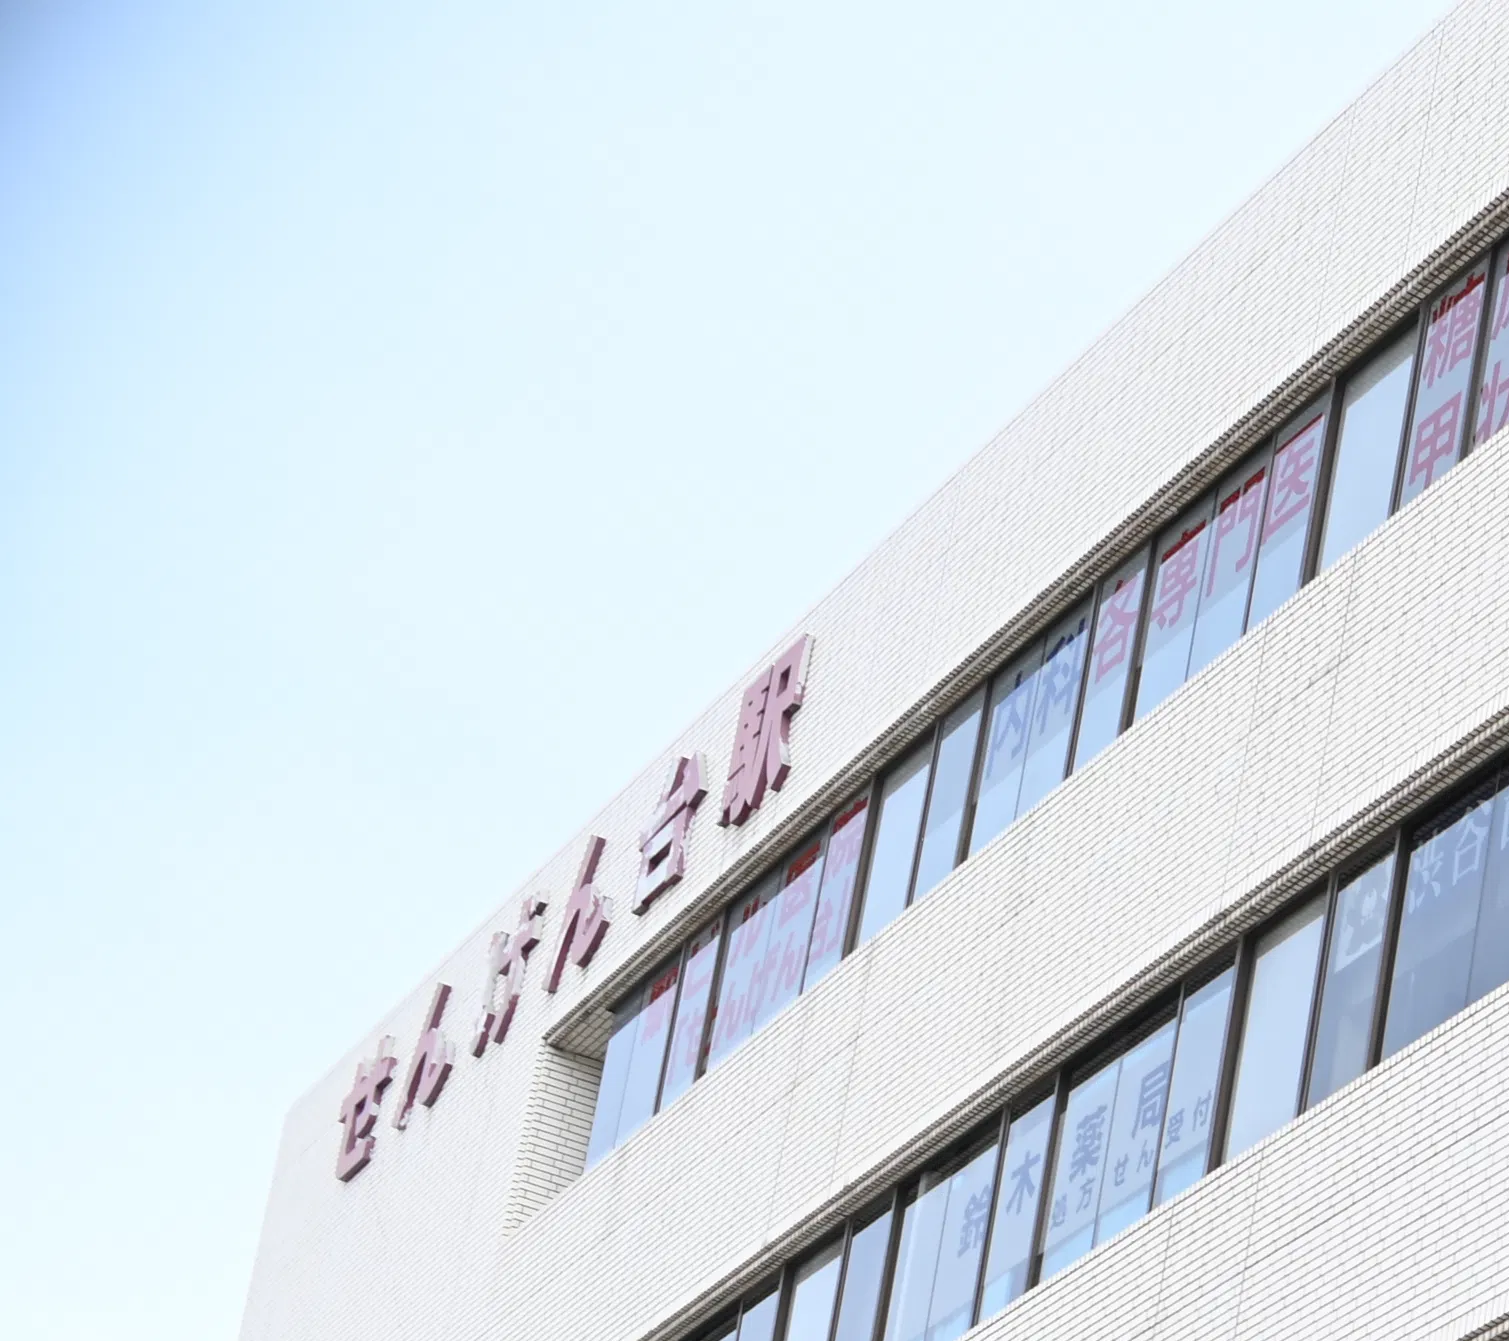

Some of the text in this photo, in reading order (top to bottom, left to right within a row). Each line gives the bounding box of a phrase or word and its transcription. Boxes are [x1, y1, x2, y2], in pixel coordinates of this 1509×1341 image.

[335, 633, 815, 1183] せんげん台駅
[957, 1060, 1171, 1258] 鈴木薬局
